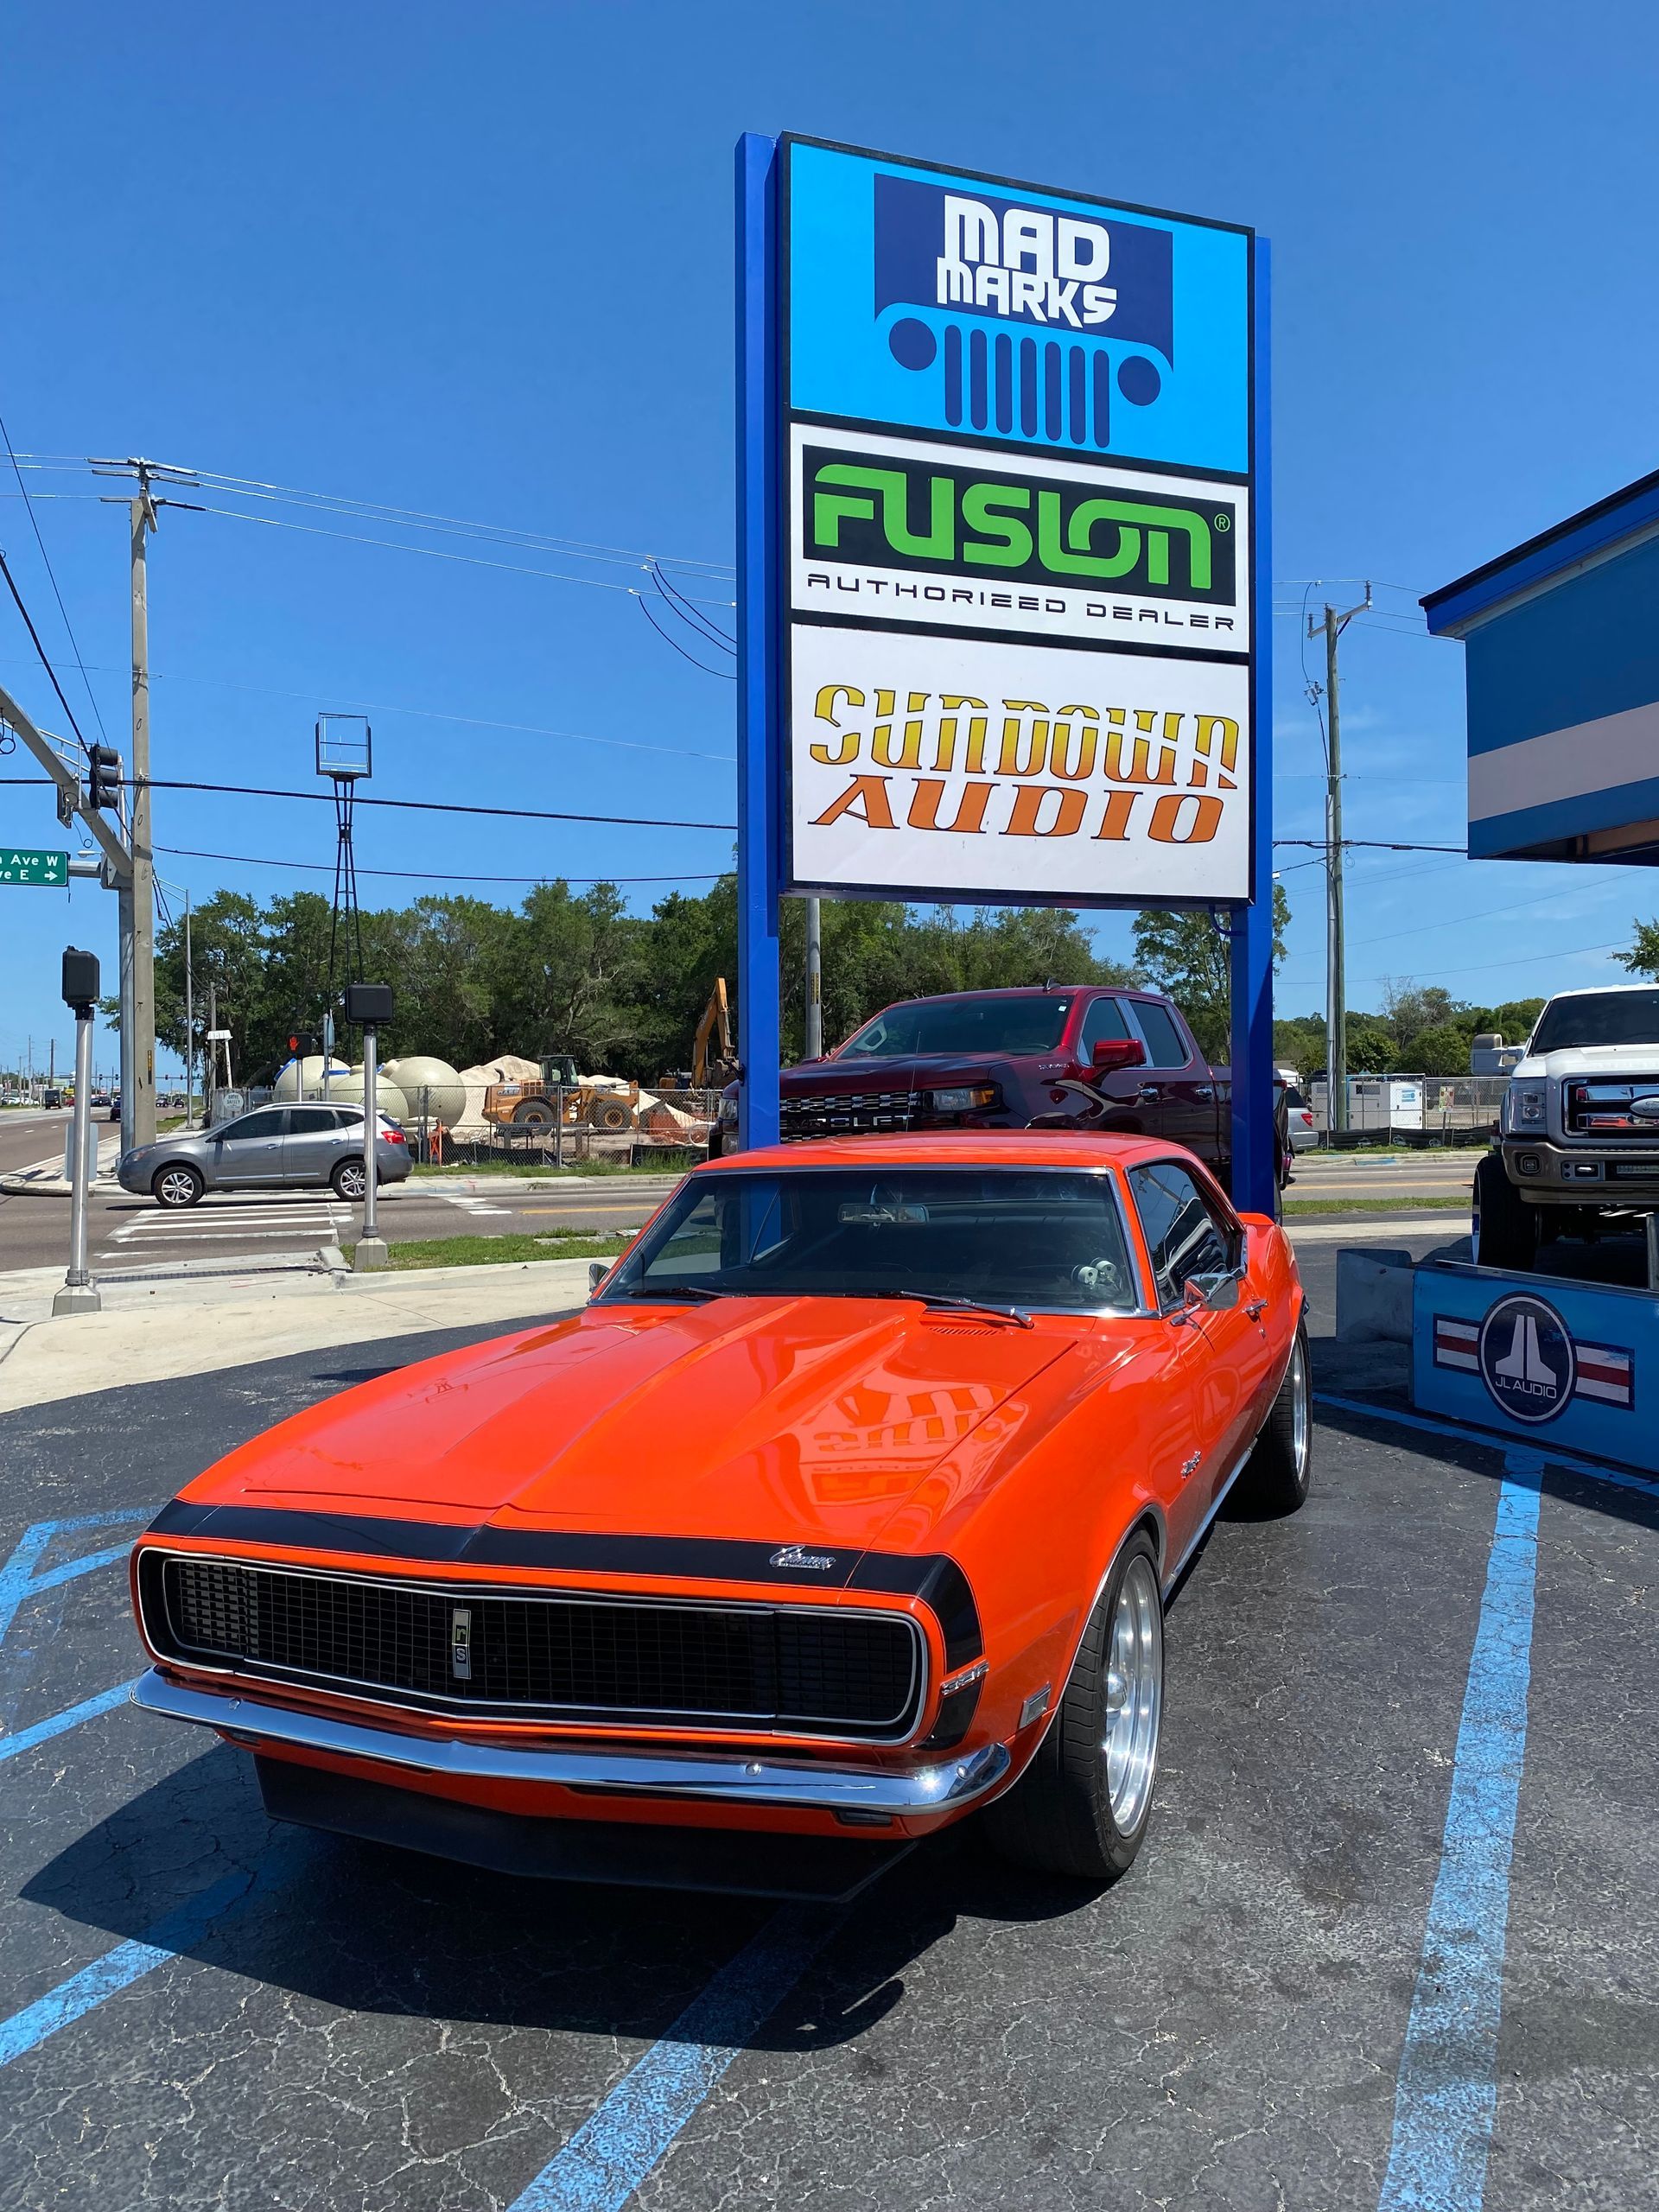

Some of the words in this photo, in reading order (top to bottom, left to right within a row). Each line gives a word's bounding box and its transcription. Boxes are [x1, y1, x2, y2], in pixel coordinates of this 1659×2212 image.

[944, 194, 1110, 283] MAD
[938, 257, 1117, 328] MARKS
[815, 464, 1211, 590] FUSION
[807, 573, 1066, 614] AUTHORIZED
[1086, 602, 1235, 632] DEALER
[810, 684, 1241, 790] SUNDOWN
[808, 774, 1224, 844] AUDIO
[10, 854, 39, 866] Ave
[46, 855, 58, 867] W
[20, 869, 29, 880] E
[1495, 1376, 1511, 1389] JL
[1512, 1379, 1557, 1400] AUDIO
